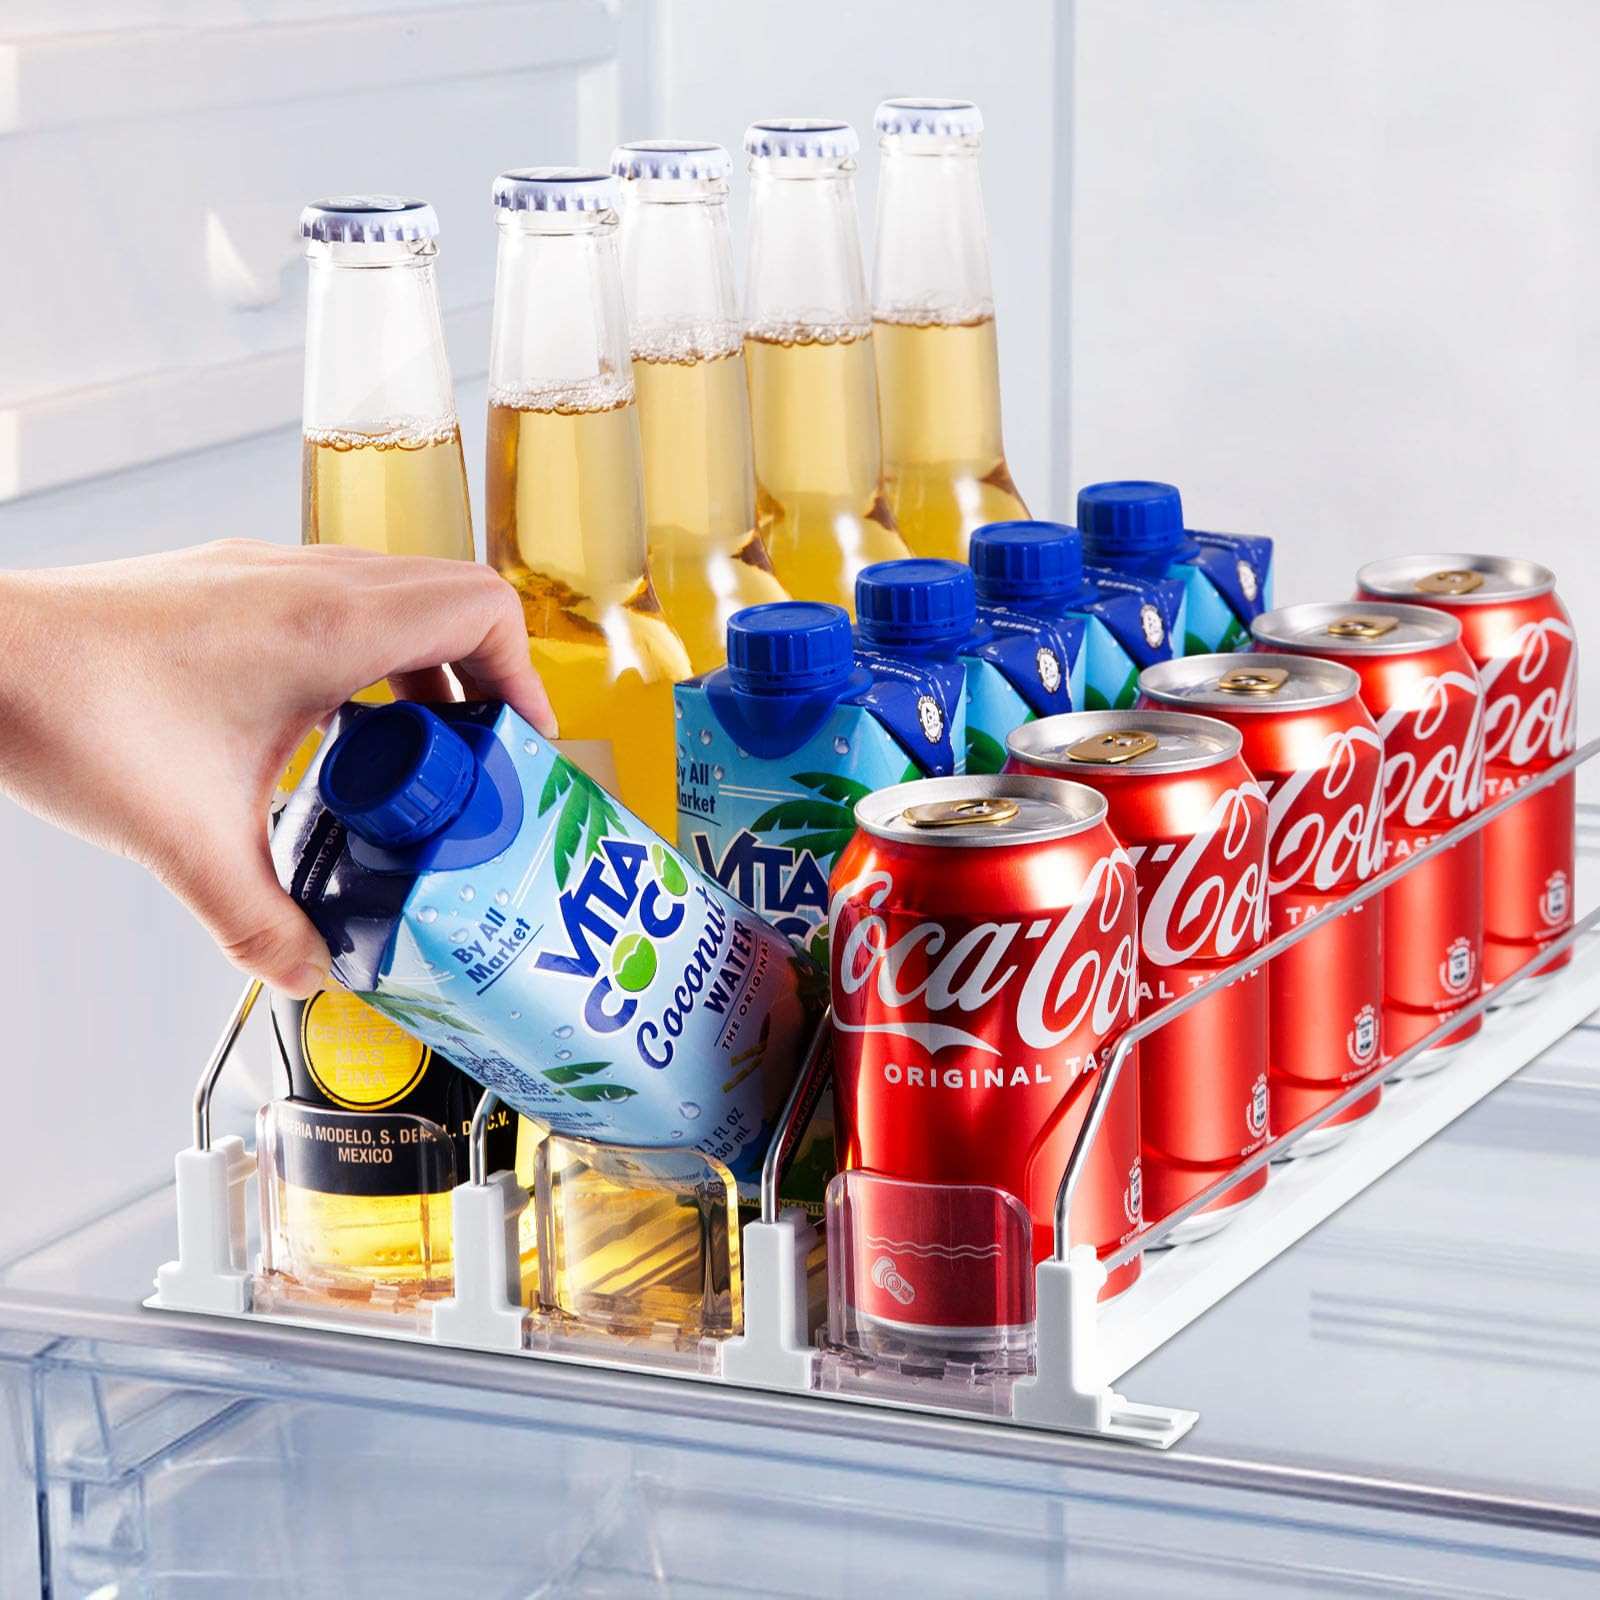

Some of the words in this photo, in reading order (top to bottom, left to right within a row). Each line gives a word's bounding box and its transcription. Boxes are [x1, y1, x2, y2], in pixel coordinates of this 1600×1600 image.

[689, 761, 710, 787] All
[692, 829, 829, 916] VITA
[532, 837, 649, 980] VITA
[452, 940, 487, 965] By
[478, 906, 508, 942] All
[465, 917, 532, 985] Market
[829, 848, 1139, 1055] Coca-Col
[637, 885, 727, 1070] Coconut
[702, 919, 753, 1016] WATER
[341, 1006, 373, 1024] LA
[721, 1020, 741, 1051] THE
[738, 939, 771, 1017] ORIGINAL
[336, 1048, 386, 1067] MAS
[884, 1063, 1052, 1090] ORIGINAL
[315, 1126, 377, 1147] MODELO,
[380, 1130, 395, 1145] S.
[713, 1125, 732, 1141] FL
[726, 1106, 745, 1126] OZ
[732, 1125, 752, 1144] mL
[338, 1147, 394, 1164] MEXICO
